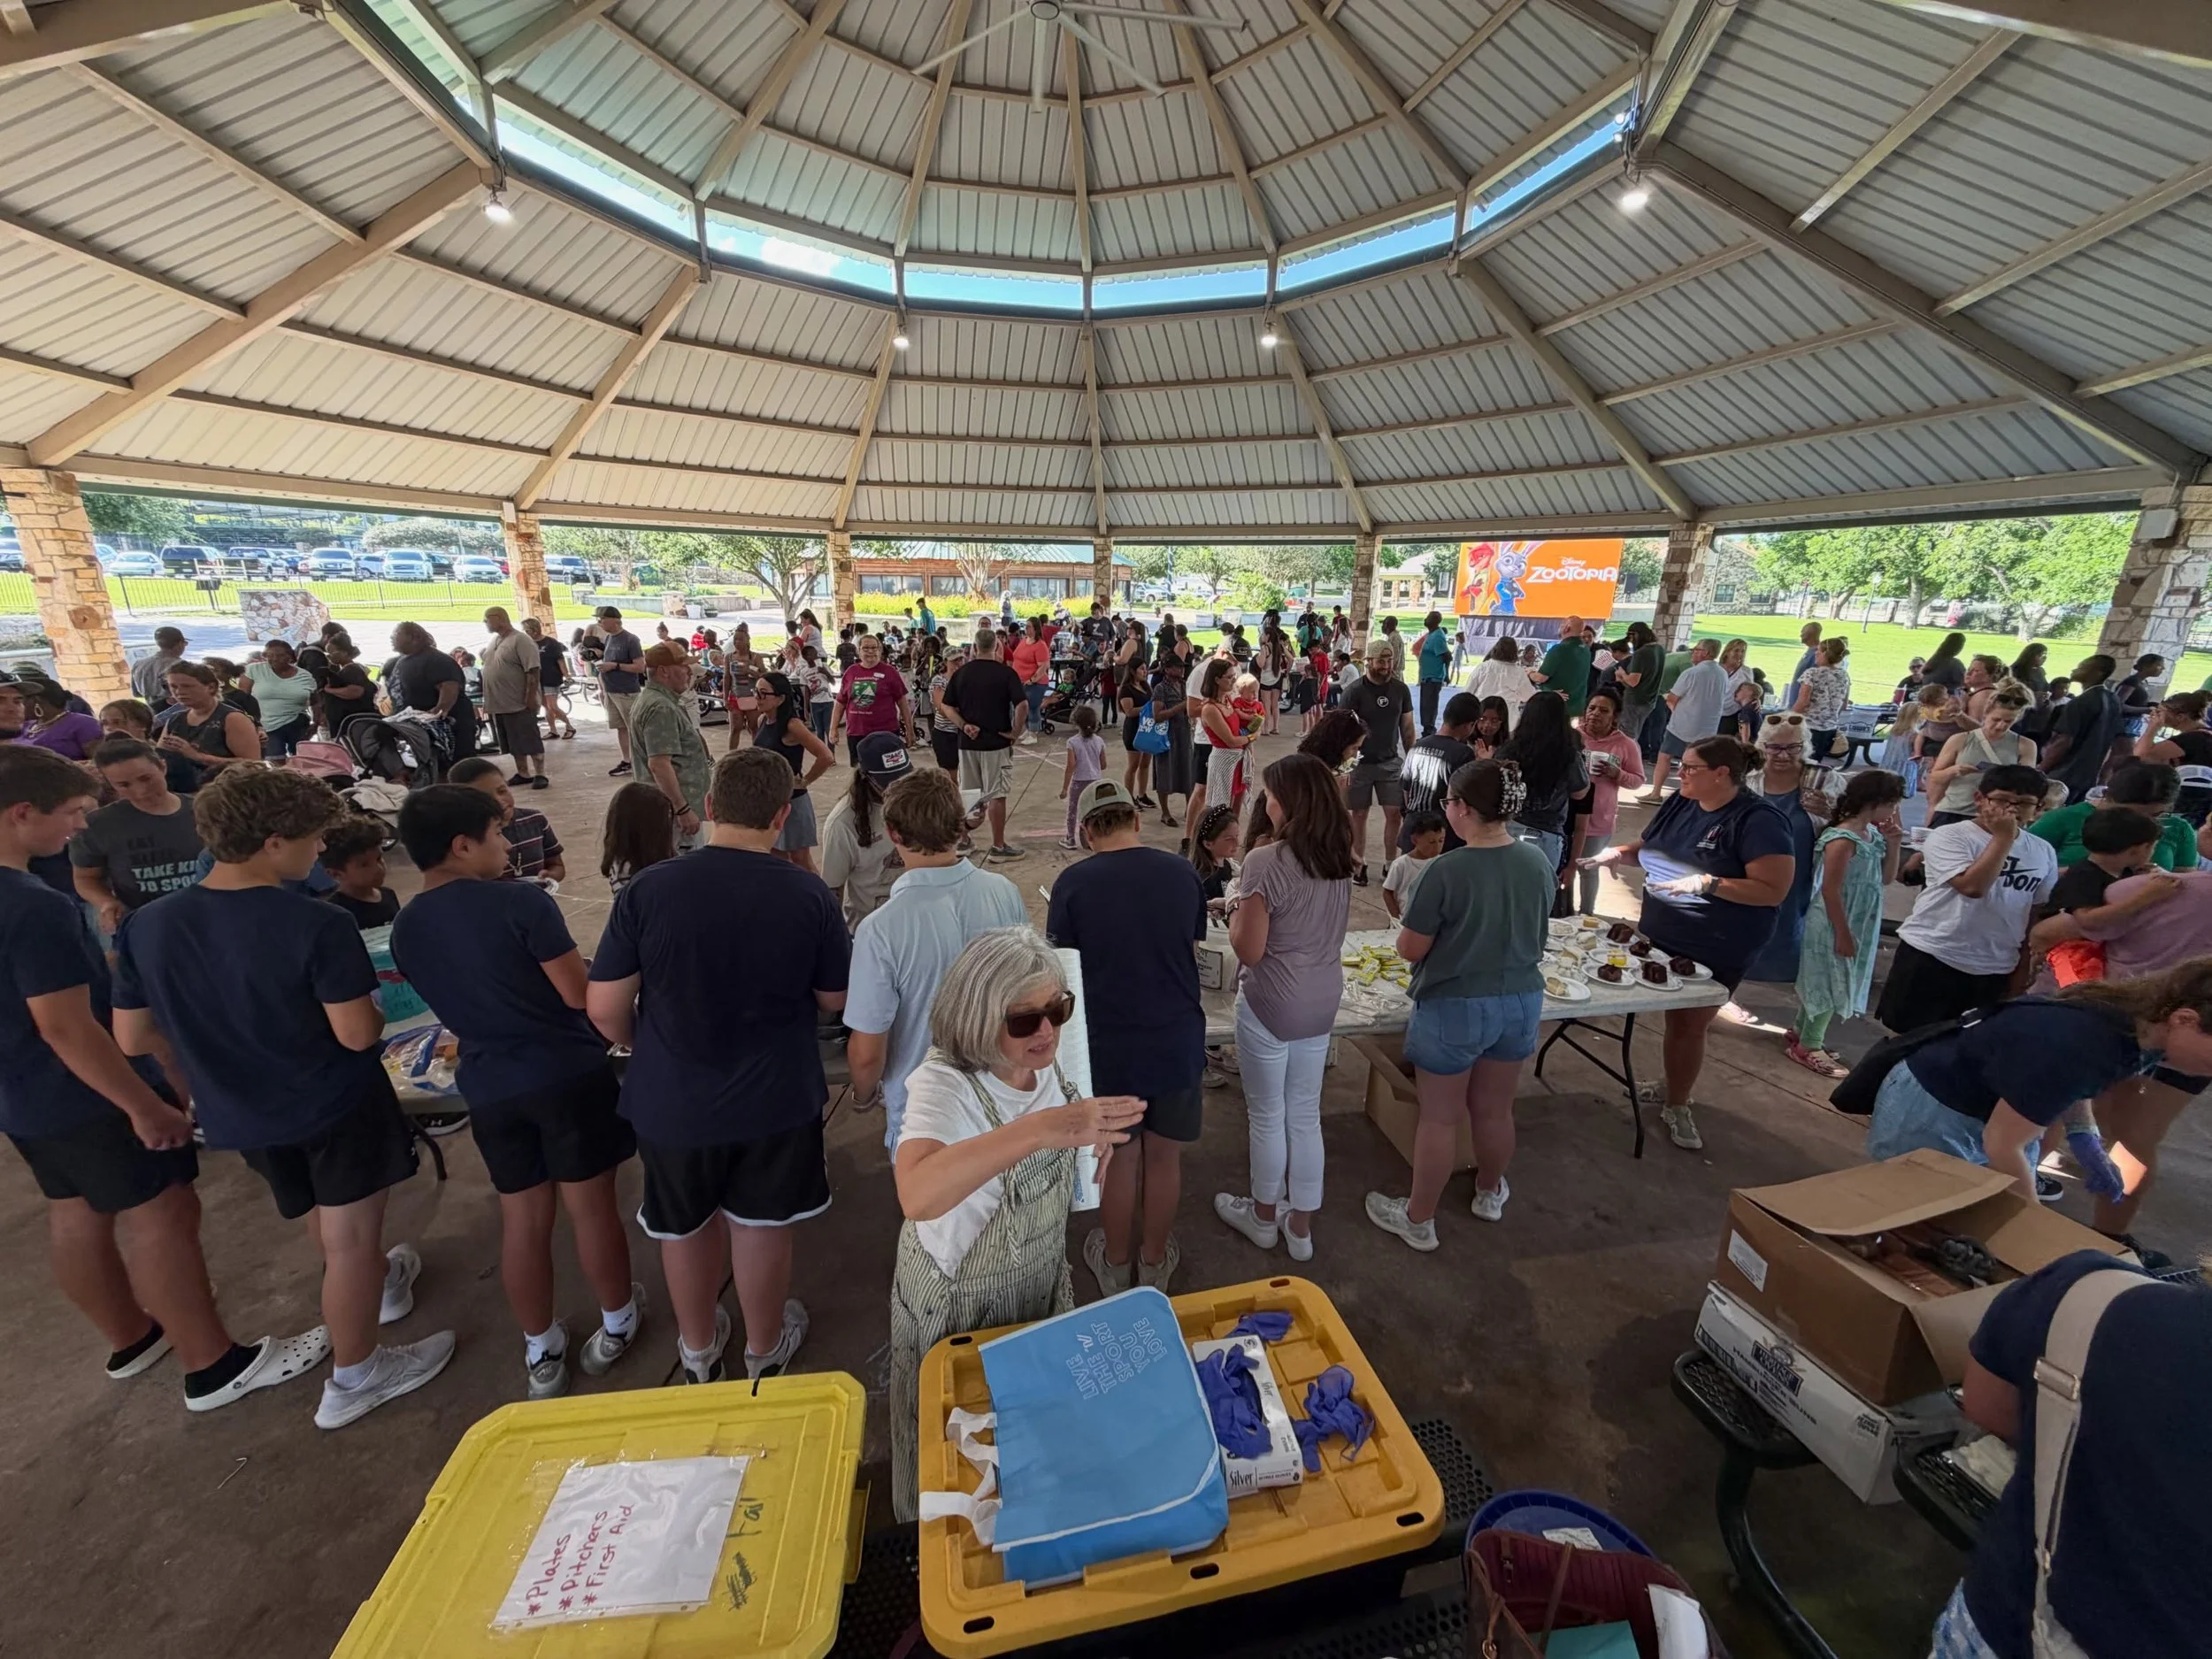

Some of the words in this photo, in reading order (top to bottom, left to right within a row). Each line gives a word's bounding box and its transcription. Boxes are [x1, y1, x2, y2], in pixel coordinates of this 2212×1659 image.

[1560, 557, 1586, 566] Disney
[1415, 746, 1445, 757] FREEDOM
[131, 864, 174, 879] TAKE
[178, 859, 197, 874] KI
[135, 880, 158, 893] TO
[1090, 1322, 1134, 1382] SPORT
[1118, 1332, 1150, 1374] YOU
[1133, 1317, 1168, 1363] LOVE
[1065, 1353, 1099, 1400] LIVE
[1087, 1352, 1117, 1394] THE
[1230, 1470, 1253, 1487] Silver
[560, 1510, 608, 1592] Pitchers
[585, 1543, 617, 1587] First
[610, 1504, 635, 1535] Aid
[525, 1533, 572, 1601] Plates
